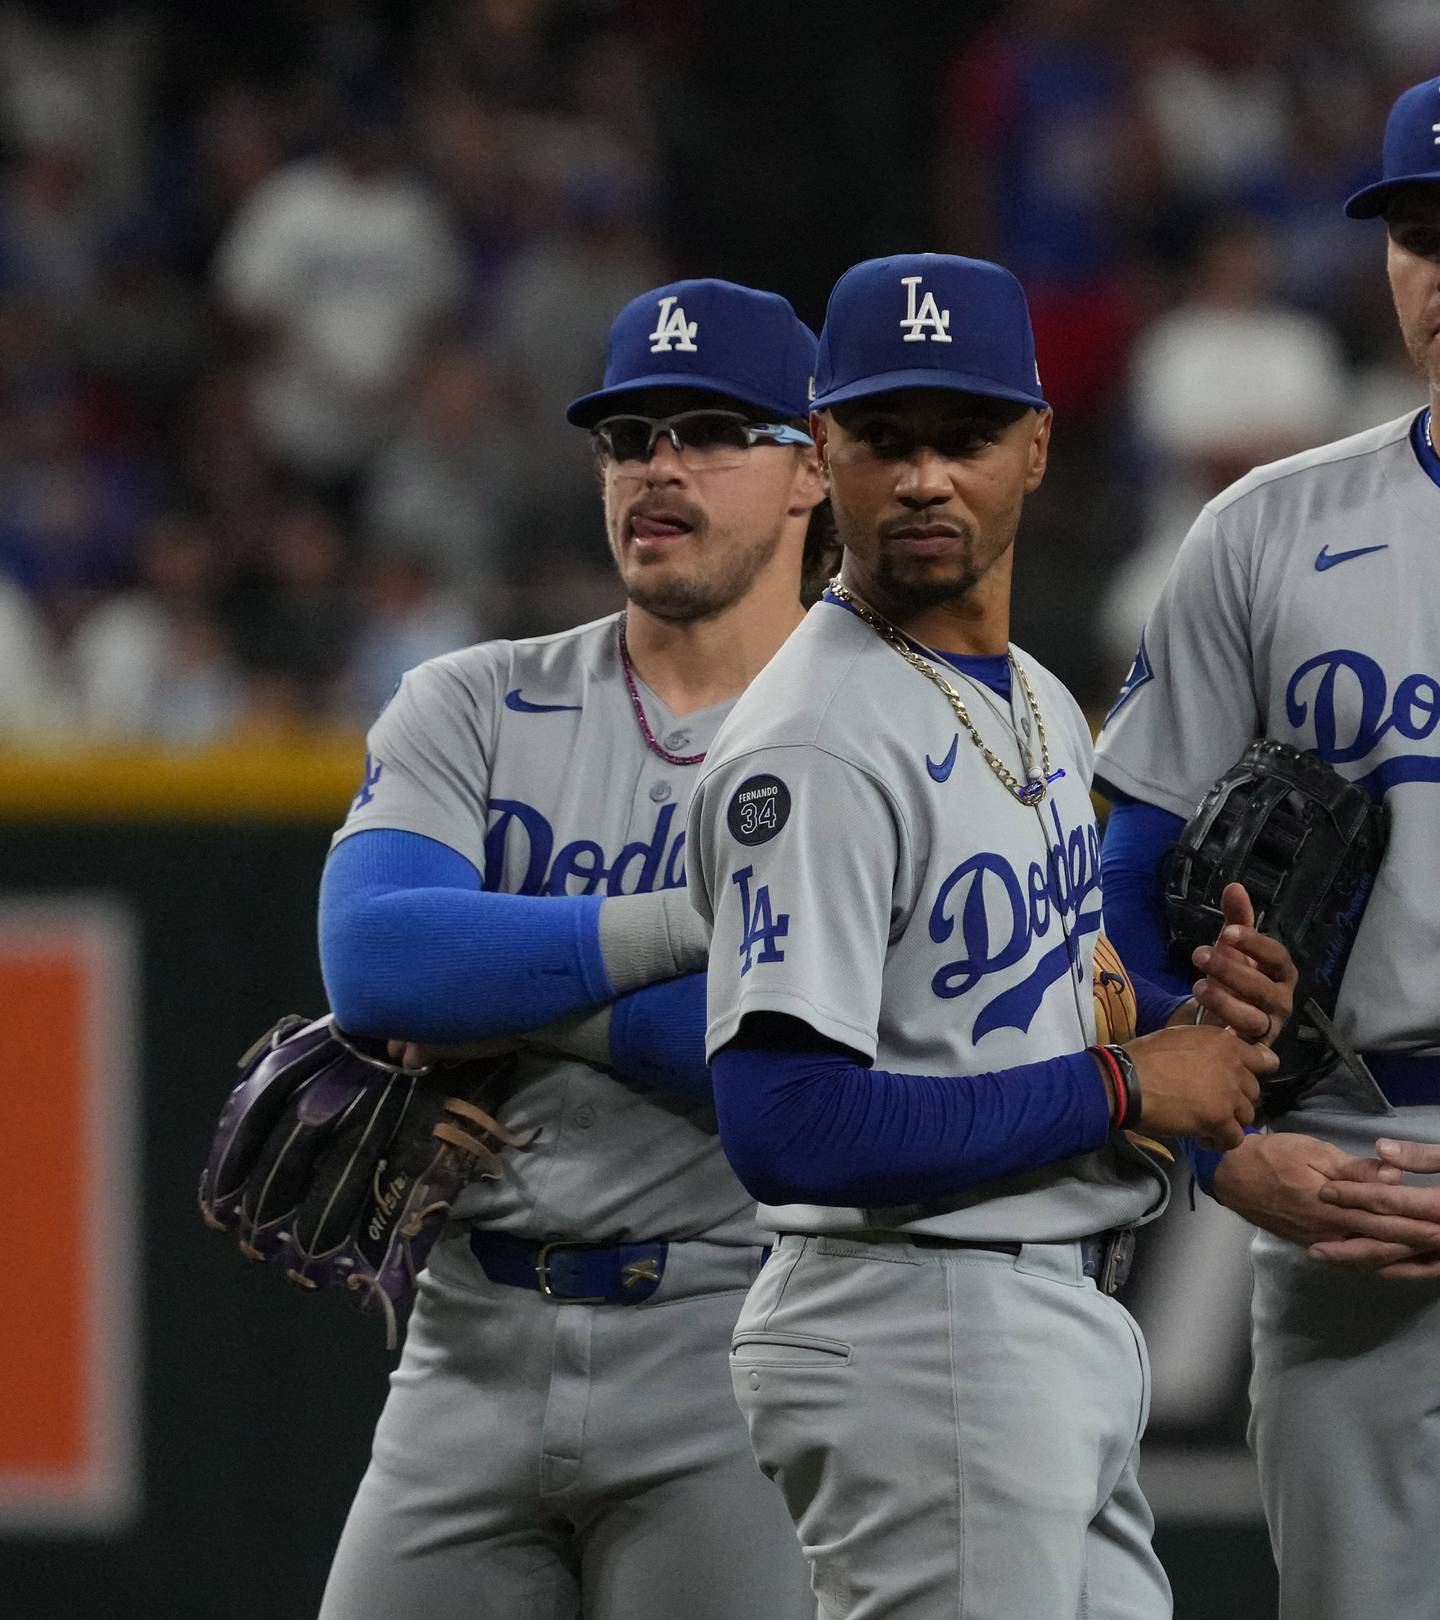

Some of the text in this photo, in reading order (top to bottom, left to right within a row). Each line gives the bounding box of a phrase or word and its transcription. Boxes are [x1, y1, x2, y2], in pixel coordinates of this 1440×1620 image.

[648, 296, 698, 353] LA
[899, 276, 953, 343] LA
[739, 786, 778, 802] FERNANDO
[740, 798, 777, 834] 34
[731, 864, 790, 977] LA
